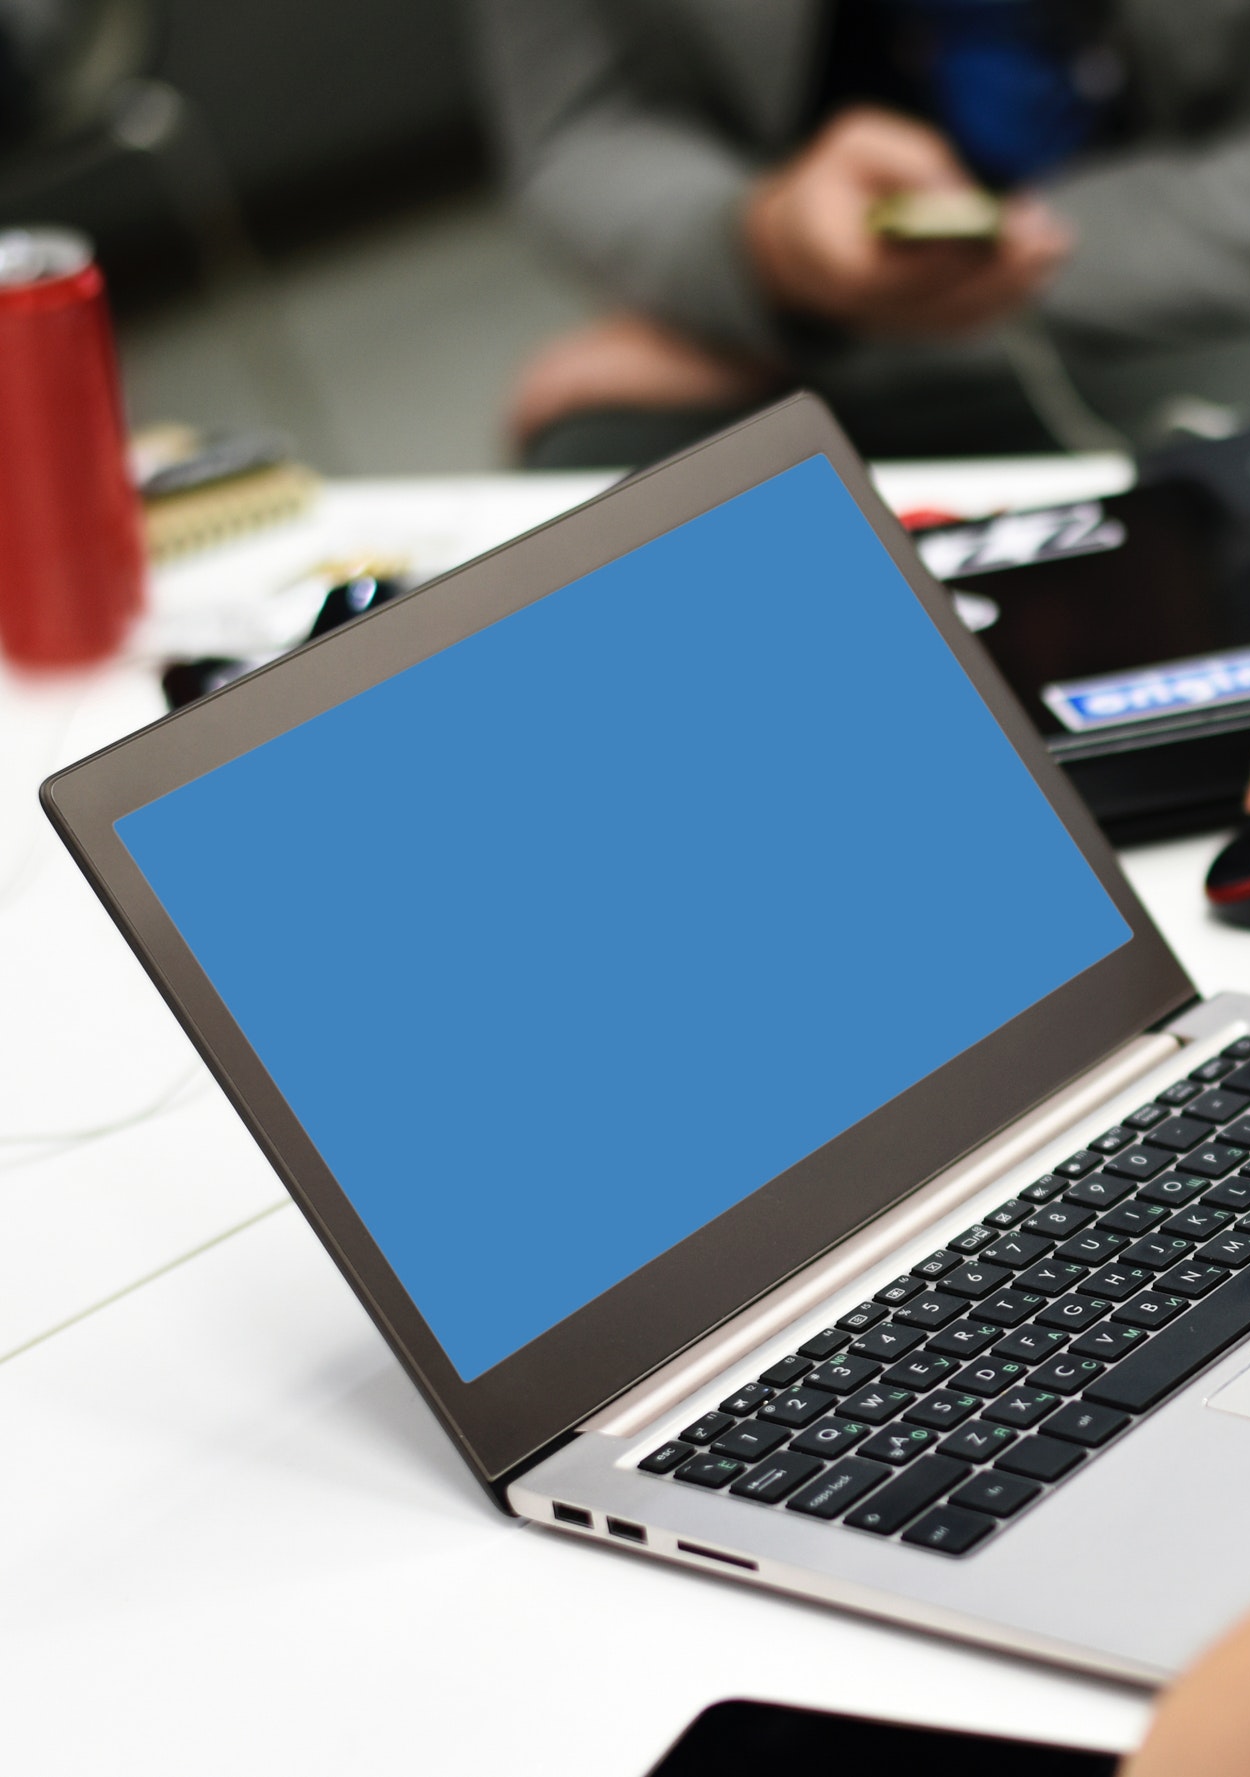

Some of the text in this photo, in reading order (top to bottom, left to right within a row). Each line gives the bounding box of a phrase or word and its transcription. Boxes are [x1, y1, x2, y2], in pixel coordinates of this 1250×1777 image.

[1203, 1154, 1217, 1162] P
[1164, 1182, 1182, 1191] O
[1050, 1214, 1066, 1222] 8
[1187, 1216, 1207, 1225] K
[1006, 1243, 1021, 1252] 7
[1081, 1240, 1100, 1249] U
[1151, 1245, 1165, 1253] J
[1222, 1240, 1244, 1252] M
[967, 1273, 982, 1281] 6
[1038, 1270, 1056, 1278] Y
[1180, 1271, 1202, 1282] N
[898, 1276, 909, 1284] f6
[1105, 1274, 1126, 1285] H
[922, 1302, 939, 1312] 5
[996, 1301, 1014, 1309] T
[1063, 1305, 1083, 1315] G
[1140, 1303, 1158, 1312] B
[881, 1334, 896, 1344] 4
[954, 1332, 974, 1341] R
[1020, 1337, 1036, 1346] F
[1095, 1333, 1115, 1345] V
[833, 1367, 852, 1376] 3
[910, 1364, 929, 1373] E
[1055, 1366, 1075, 1377] C
[976, 1370, 996, 1380] D
[788, 1399, 807, 1409] 2
[861, 1394, 884, 1408] W
[1010, 1399, 1032, 1411] X
[933, 1402, 952, 1412] S
[707, 1412, 719, 1420] f1
[1078, 1414, 1093, 1426] alt
[818, 1429, 841, 1441] Q
[965, 1432, 988, 1445] Z
[890, 1436, 909, 1447] A
[657, 1448, 675, 1461] esc
[809, 1473, 853, 1508] caps lock
